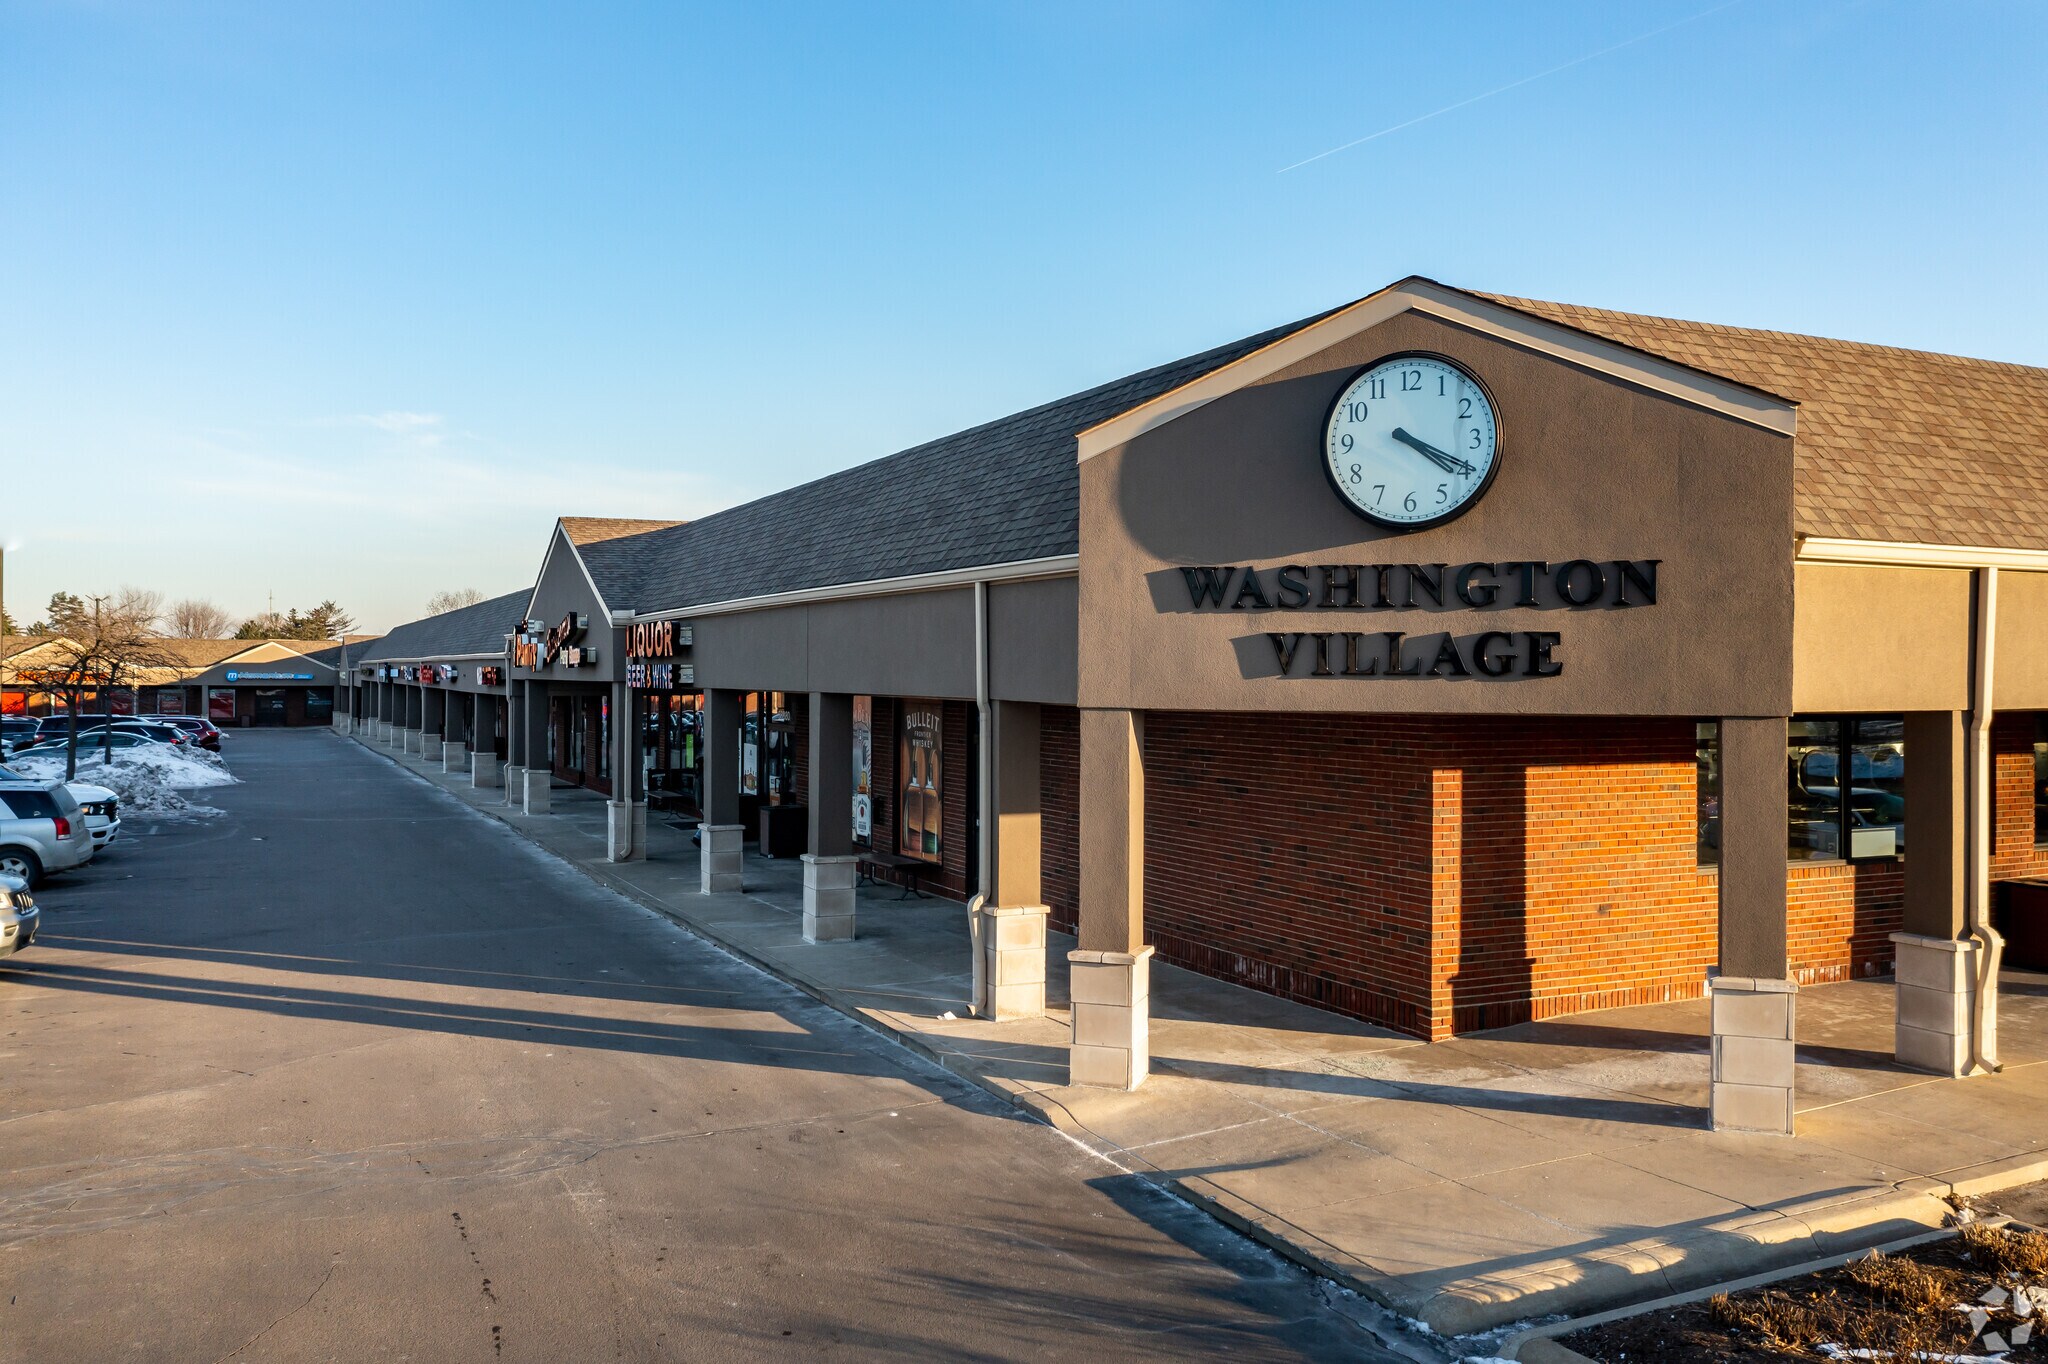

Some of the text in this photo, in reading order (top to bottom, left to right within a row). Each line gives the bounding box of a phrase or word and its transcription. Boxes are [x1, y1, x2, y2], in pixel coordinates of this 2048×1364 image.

[1370, 378, 1387, 399] 11
[1400, 369, 1423, 391] 12
[1438, 374, 1446, 397] 1
[1348, 401, 1368, 423] 10
[1458, 398, 1472, 419] 2
[1341, 433, 1354, 454] 9
[1469, 428, 1482, 450] 3
[1350, 463, 1362, 485] 8
[1456, 459, 1472, 481] 4
[1372, 484, 1385, 506] 7
[1403, 491, 1417, 513] 6
[1435, 483, 1448, 505] 5
[1179, 559, 1664, 609] WASHINGTON
[626, 620, 673, 657] LIQUOR
[1266, 631, 1564, 678] VILLAGE
[626, 664, 646, 688] BEER
[652, 664, 673, 689] WINE
[906, 711, 940, 732] BULLEIT
[912, 738, 934, 748] WHISKEY
